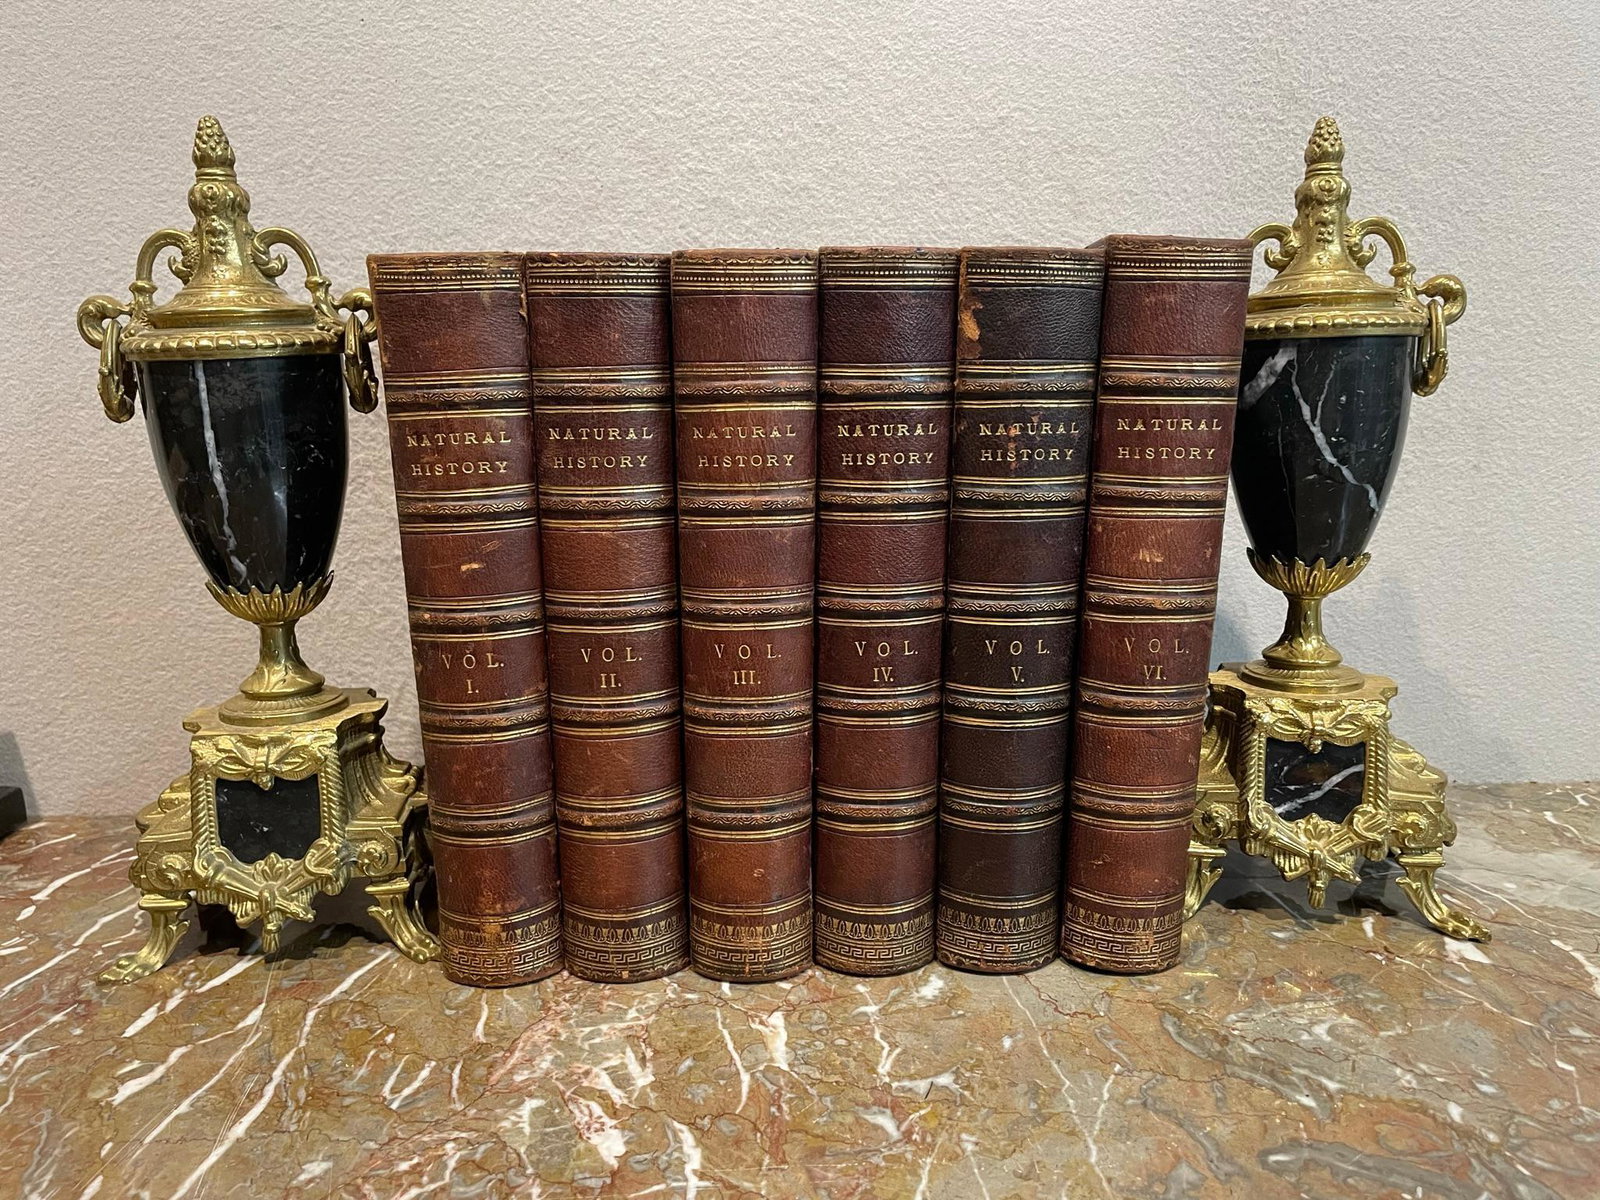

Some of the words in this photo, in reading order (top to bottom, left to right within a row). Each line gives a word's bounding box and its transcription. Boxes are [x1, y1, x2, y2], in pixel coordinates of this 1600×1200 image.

[692, 424, 797, 438] NATURAL
[837, 423, 938, 437] NATURAL
[979, 422, 1079, 436] NATURAL
[1117, 418, 1222, 431] NATURAL
[407, 431, 512, 448] NATURAL
[549, 427, 654, 441] NATURAL
[698, 454, 795, 467] HISTORY
[841, 452, 934, 466] HISTORY
[981, 449, 1073, 462] HISTORY
[1118, 447, 1215, 460] HISTORY
[411, 461, 509, 476] HISTORY
[553, 455, 649, 469] HISTORY
[733, 670, 761, 686] III.
[873, 667, 894, 682] IV.
[1010, 666, 1025, 682] V.
[1143, 665, 1167, 680] VI.
[466, 679, 479, 694] I.
[600, 673, 622, 688] II.
